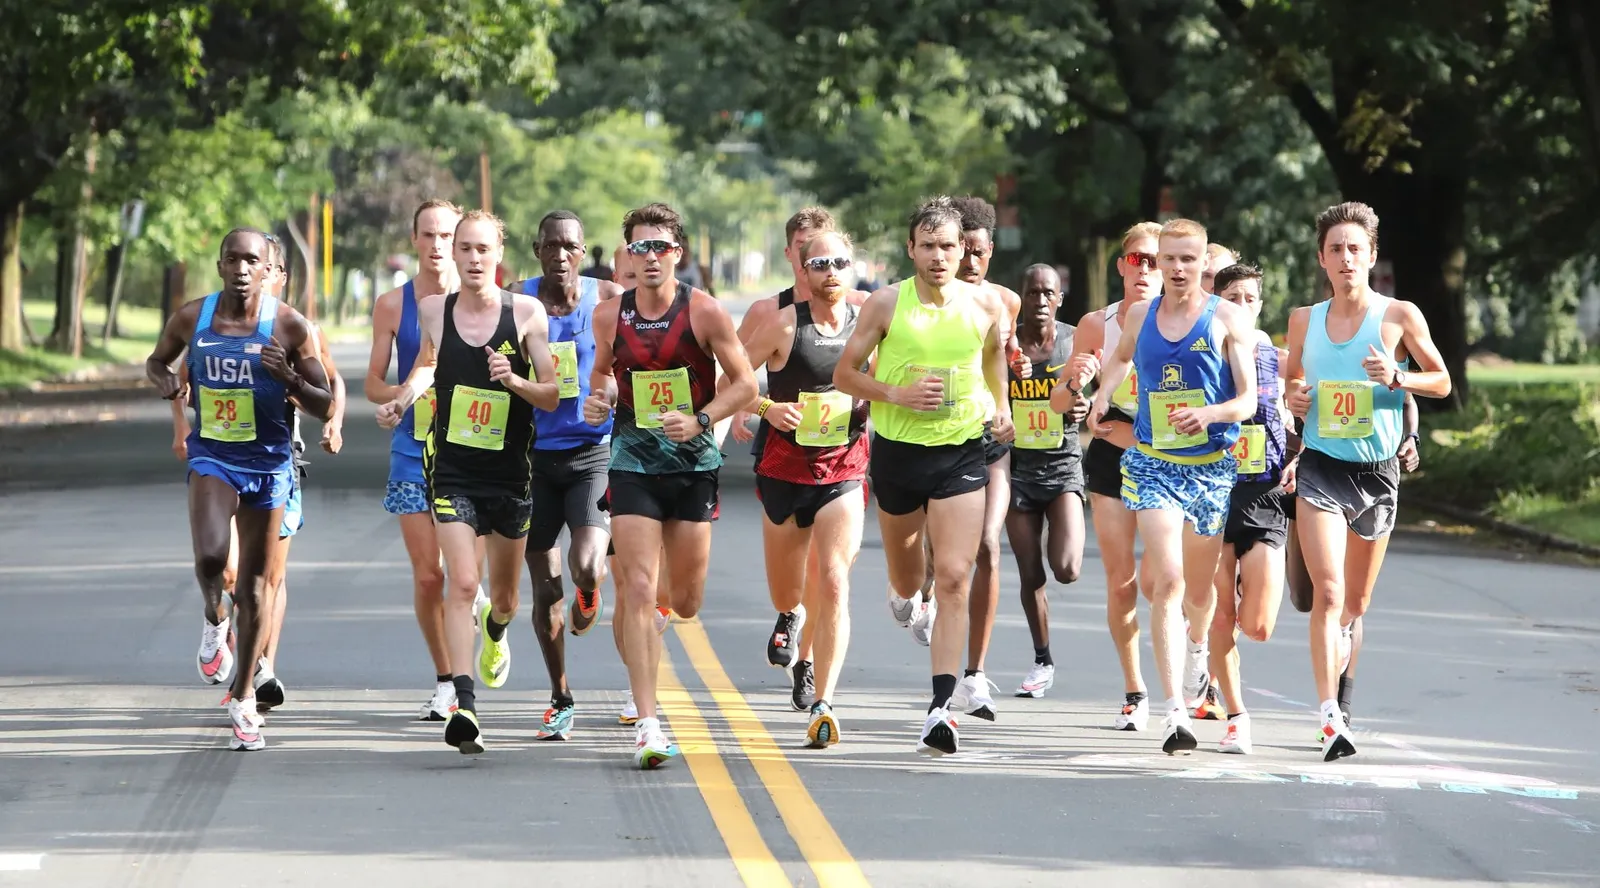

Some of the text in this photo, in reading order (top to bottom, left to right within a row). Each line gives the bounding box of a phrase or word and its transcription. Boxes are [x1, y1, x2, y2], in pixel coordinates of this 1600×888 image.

[635, 320, 670, 330] saucony
[205, 355, 254, 385] USA
[635, 371, 684, 380] FaxonLawGroup
[459, 388, 507, 401] FaxonLawGroup
[649, 381, 674, 406] 25
[1010, 377, 1060, 399] ARMY
[213, 399, 237, 422] 28
[467, 400, 491, 426] 40
[819, 403, 831, 426] 2
[1333, 392, 1356, 416] 20
[1028, 410, 1048, 431] 10
